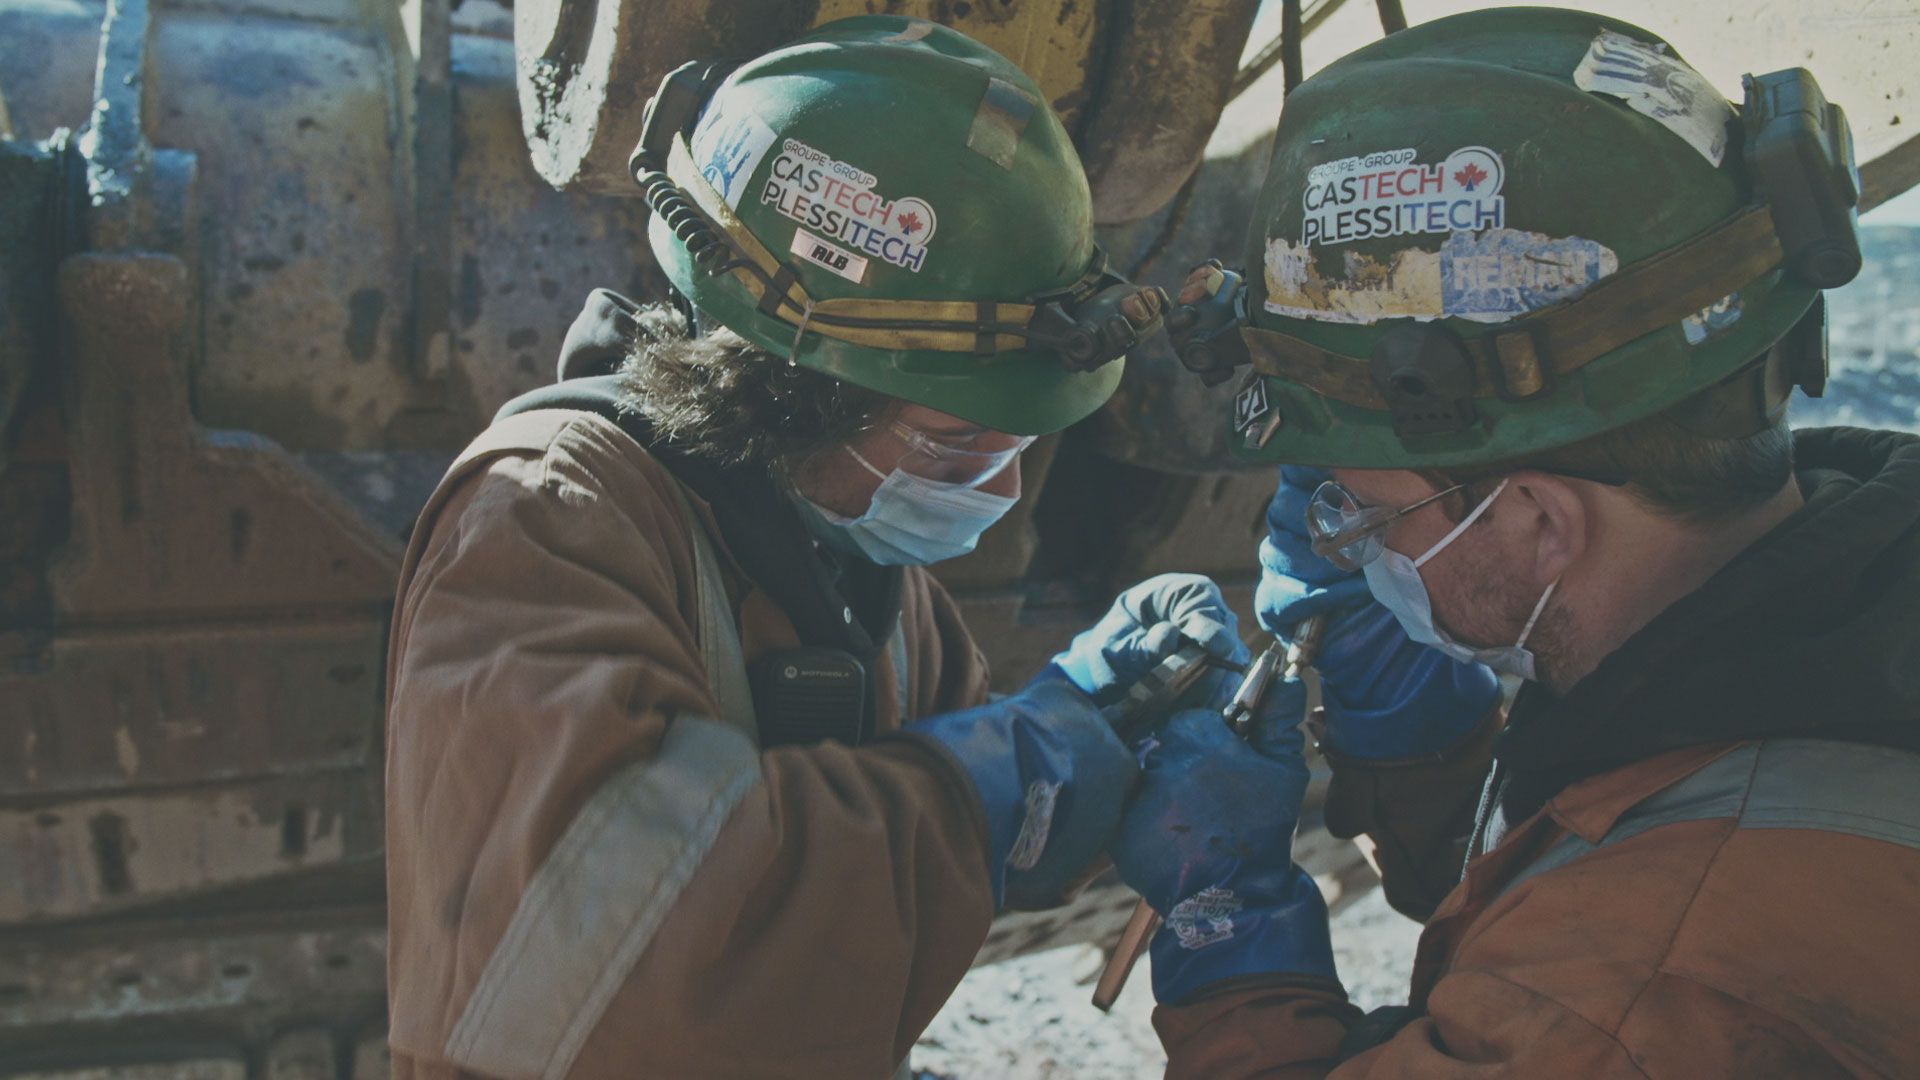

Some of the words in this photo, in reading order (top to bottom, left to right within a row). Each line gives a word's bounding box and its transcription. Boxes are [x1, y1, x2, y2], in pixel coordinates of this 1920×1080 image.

[784, 140, 826, 167] GROUPE
[832, 162, 875, 187] GROUP
[1364, 151, 1414, 169] GROUP
[773, 156, 893, 225] CASTECH
[1305, 166, 1444, 212] CASTECH
[763, 181, 925, 269] PLESSITECH
[1303, 199, 1501, 246] PLESSITECH
